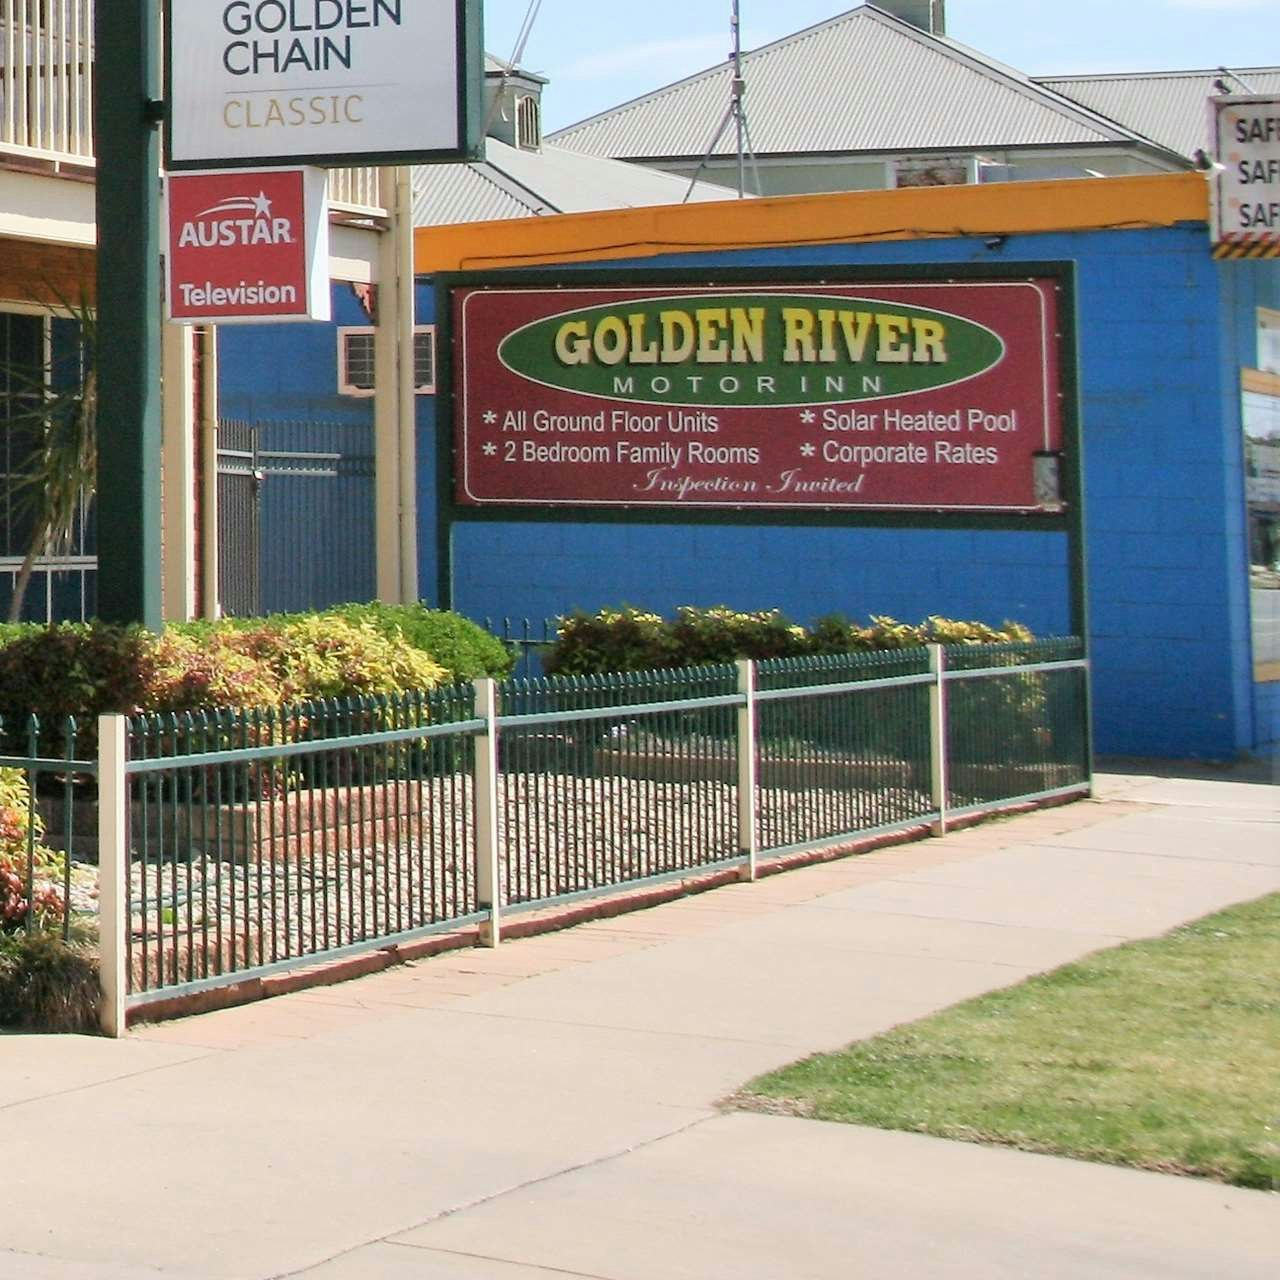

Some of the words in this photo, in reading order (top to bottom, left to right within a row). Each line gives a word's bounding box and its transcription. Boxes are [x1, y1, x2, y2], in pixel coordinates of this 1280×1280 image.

[222, 35, 351, 75] CHAIN
[223, 95, 364, 129] CLASSIC
[1236, 118, 1280, 143] SAF
[178, 218, 291, 248] AUSTAR
[178, 280, 296, 307] Television
[554, 306, 766, 366] GOLDEN
[782, 307, 948, 363] RIVER
[613, 376, 776, 394] MOTOR
[800, 375, 881, 393] INN
[503, 410, 527, 432] All
[533, 409, 605, 433] Ground
[611, 410, 662, 433] Floor
[668, 410, 719, 433] Units
[822, 409, 878, 432] Solar
[883, 409, 960, 432] Heated
[967, 409, 1018, 433] Pool
[504, 440, 517, 463] 2
[523, 440, 610, 463] Bedroom
[616, 441, 682, 469] Family
[688, 441, 760, 465] Rooms
[822, 440, 928, 468] Corporate
[935, 441, 999, 465] Rates
[633, 467, 758, 500] Inspection
[766, 468, 865, 495] Invited
